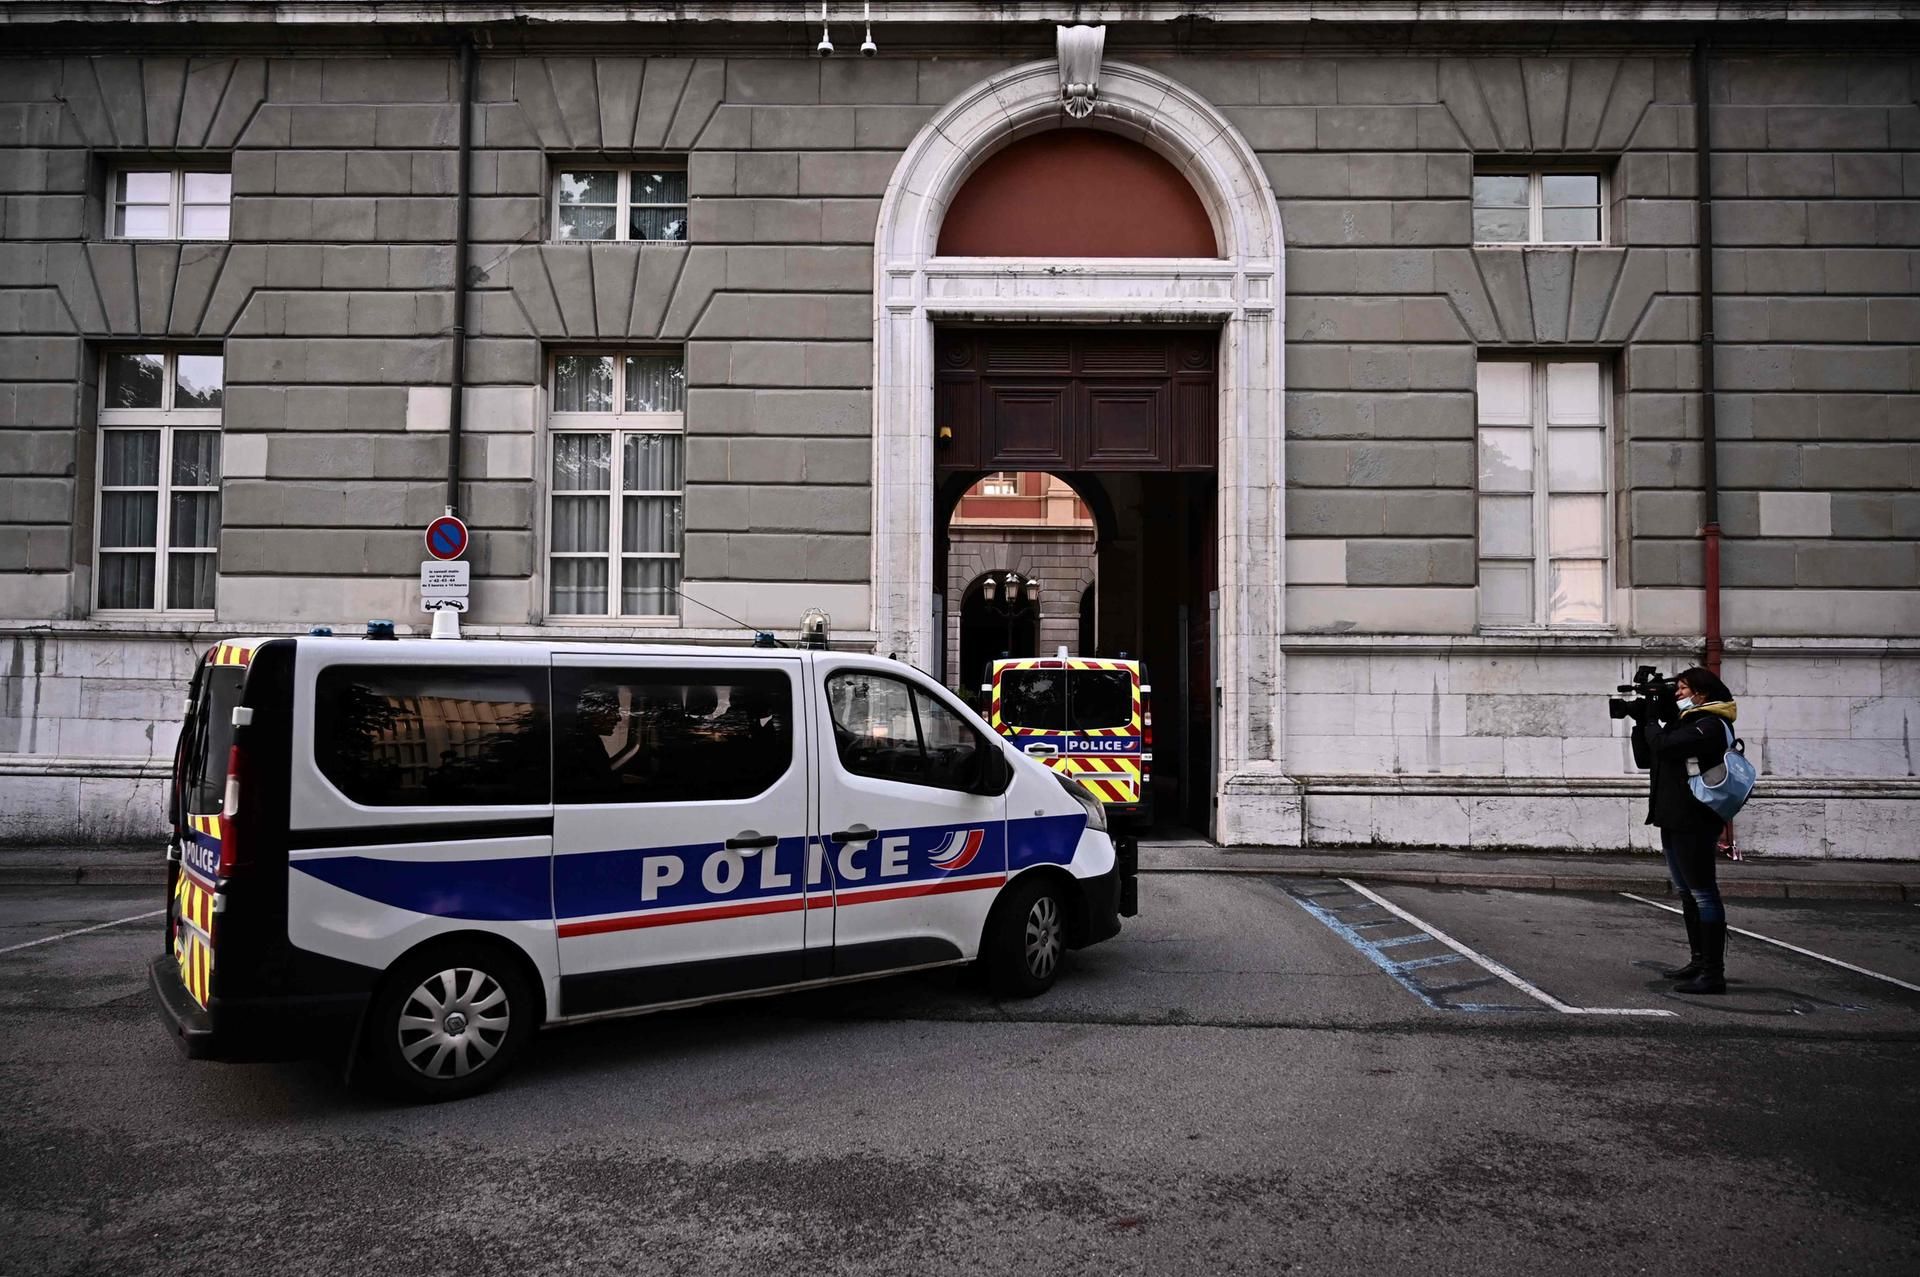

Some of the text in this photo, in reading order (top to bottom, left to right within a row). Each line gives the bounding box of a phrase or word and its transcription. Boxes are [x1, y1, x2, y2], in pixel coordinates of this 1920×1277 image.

[1069, 740, 1122, 750] POLICE
[187, 840, 214, 874] POLICE
[641, 836, 910, 902] POLICE
